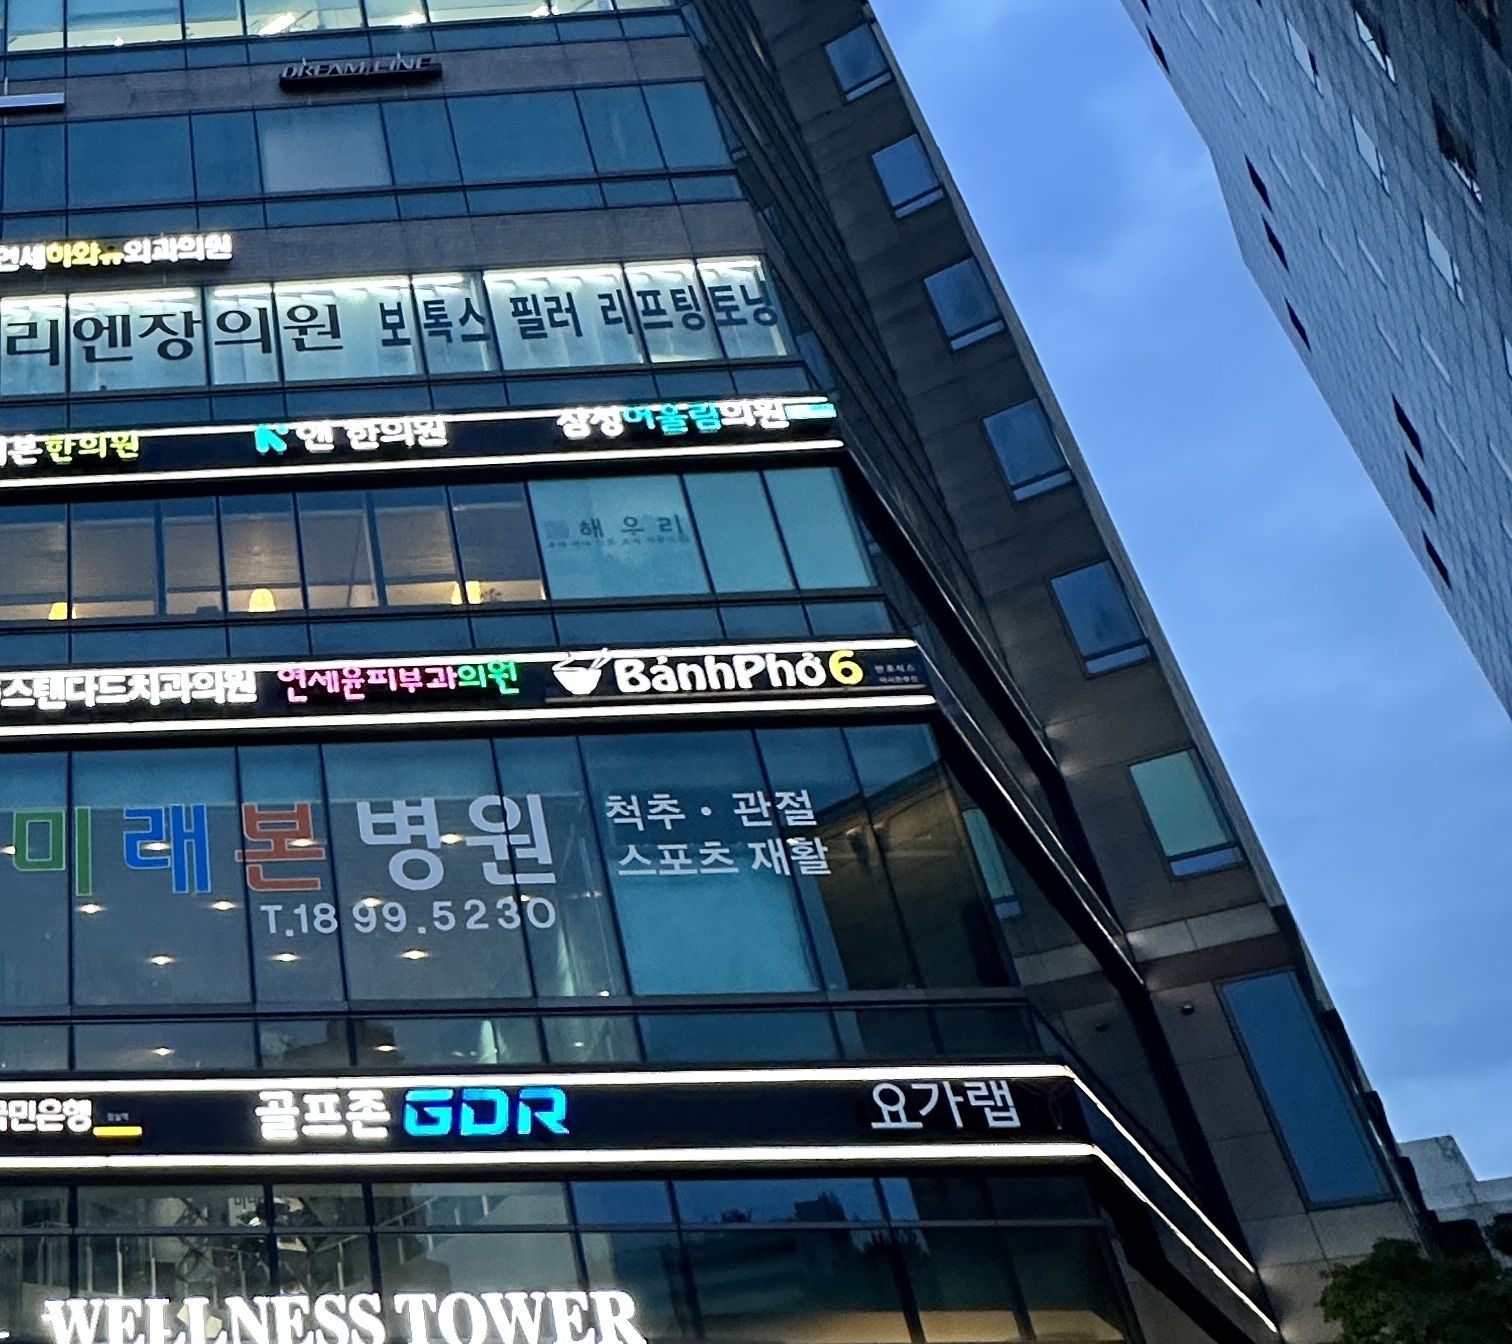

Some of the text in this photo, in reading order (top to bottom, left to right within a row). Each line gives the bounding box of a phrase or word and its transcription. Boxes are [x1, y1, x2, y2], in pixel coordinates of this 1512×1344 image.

[6, 302, 344, 367] 리엔장의원
[379, 296, 491, 348] 보톡스
[509, 291, 584, 341] 필러
[276, 659, 520, 704] 연세윤피부과의원
[605, 793, 687, 832] 척추
[731, 789, 818, 828] 관절
[12, 792, 556, 897] 미래본병원
[618, 836, 832, 877] 스포츠 재활
[254, 1086, 571, 1140] 골프존 GDR
[871, 1080, 1021, 1130] 요가랩
